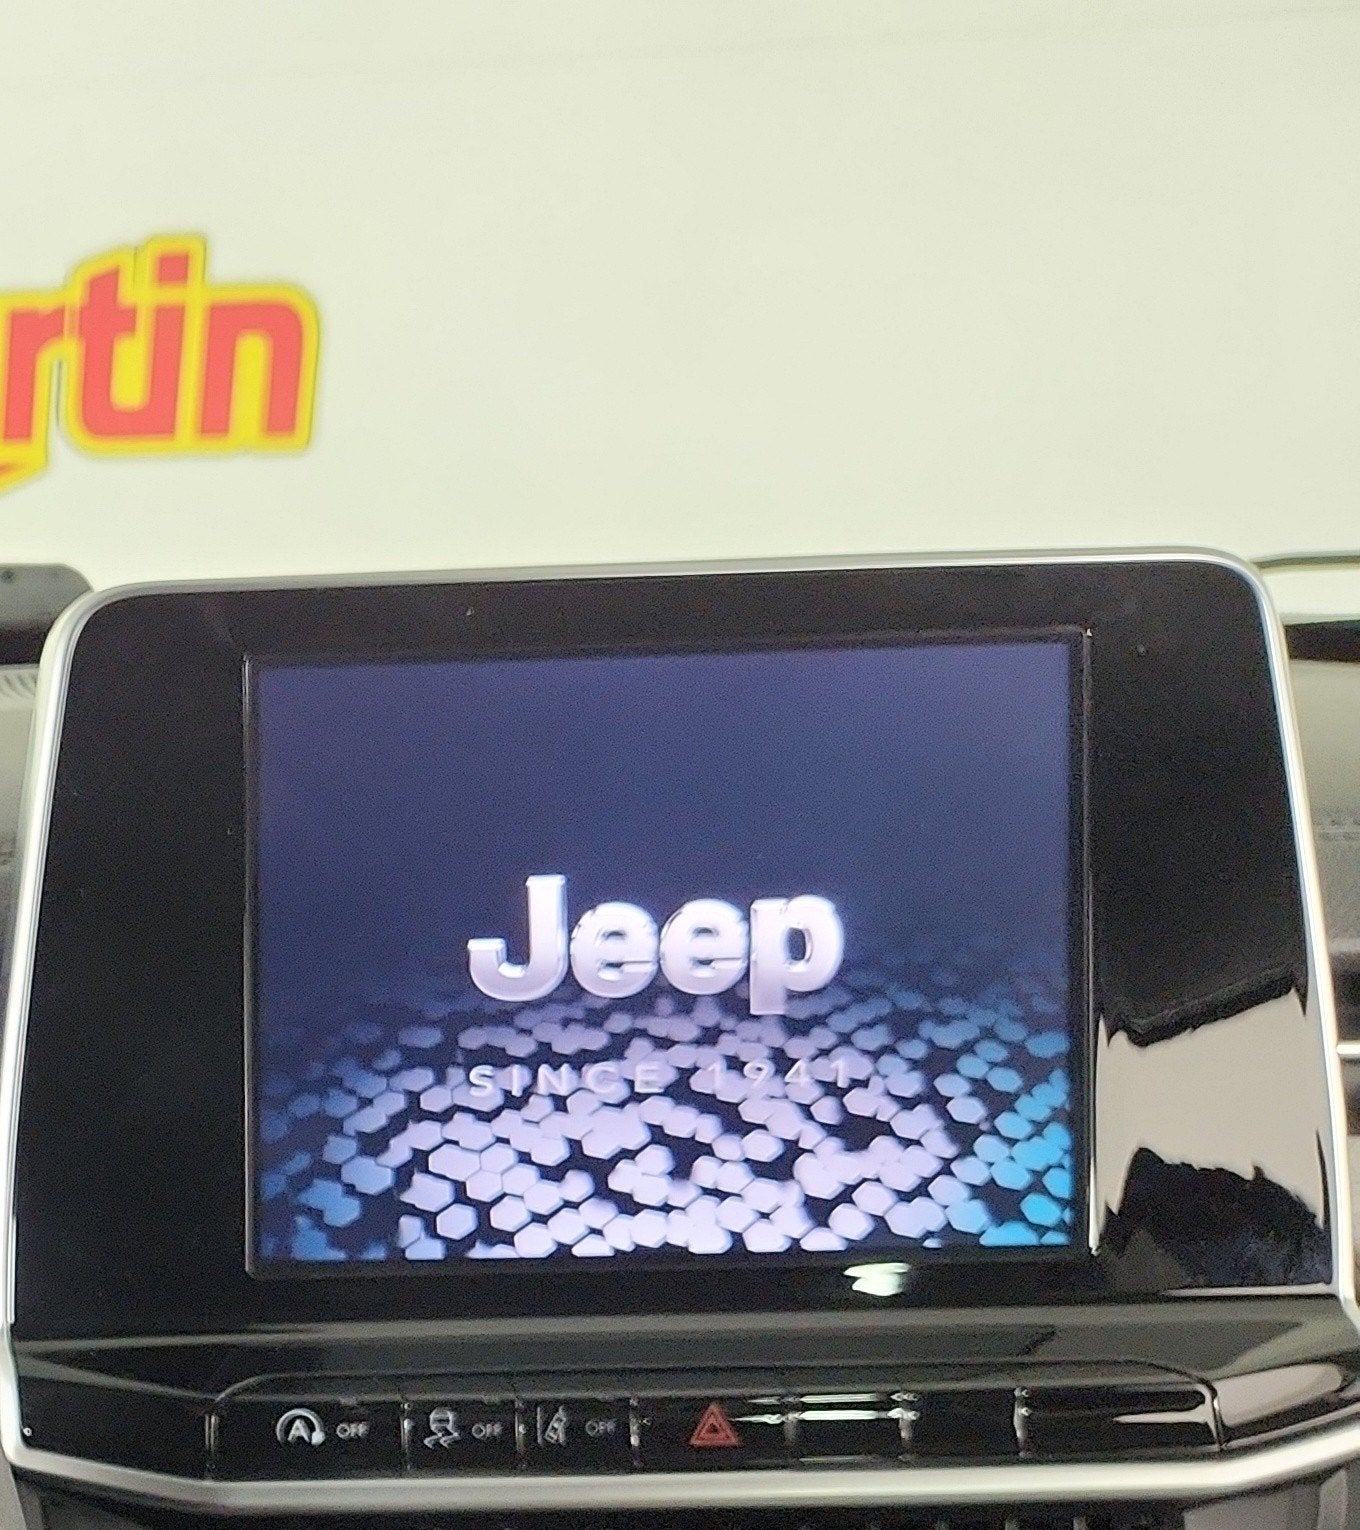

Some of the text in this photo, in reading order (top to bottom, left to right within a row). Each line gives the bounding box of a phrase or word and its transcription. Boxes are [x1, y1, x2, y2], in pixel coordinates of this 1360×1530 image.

[467, 874, 844, 1015] Jeep
[468, 1060, 665, 1097] SINCE
[335, 1421, 369, 1439] OFF
